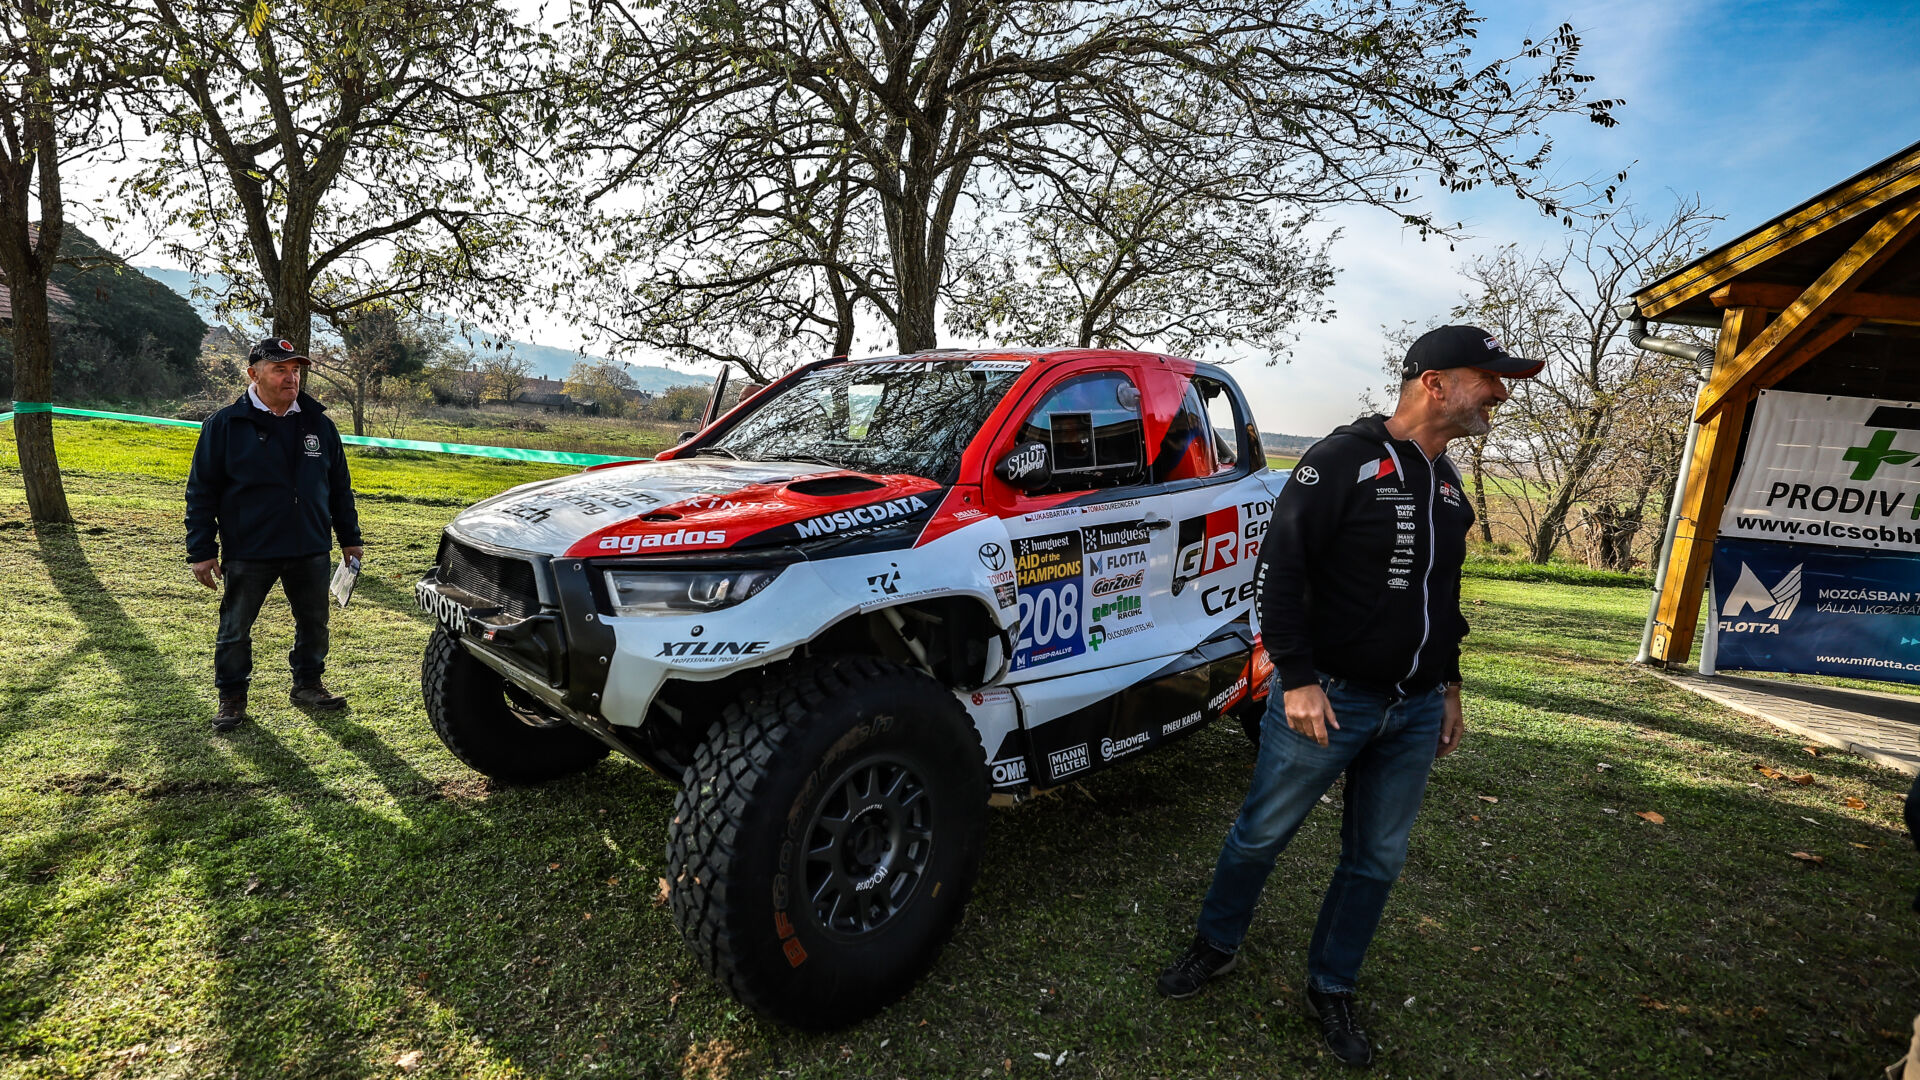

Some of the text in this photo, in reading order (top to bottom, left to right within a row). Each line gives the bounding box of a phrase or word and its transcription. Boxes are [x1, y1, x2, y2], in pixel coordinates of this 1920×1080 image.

[1008, 449, 1046, 480] SHOT
[686, 497, 785, 510] KINTO
[1766, 482, 1905, 517] PRODIV
[794, 496, 928, 539] MUSICDATA
[599, 529, 726, 553] agados
[840, 527, 871, 538] PLUG
[1100, 527, 1150, 545] hunguest
[1031, 535, 1069, 551] hunguest
[1041, 555, 1048, 564] of
[1049, 553, 1060, 562] the
[1107, 551, 1147, 569] FLOTTA
[1176, 531, 1238, 578] GR
[987, 570, 1015, 585] TOYOTA
[1016, 561, 1081, 586] HAMPIONS
[1819, 588, 1910, 602] MOZGÁSBAN
[418, 586, 466, 633] TOYOTA
[1017, 583, 1079, 651] 208
[1118, 608, 1142, 620] RACING
[1718, 621, 1780, 634] FLOTTA
[654, 641, 770, 657] XTLINE
[671, 656, 716, 664] PROFESSIONAL
[1208, 677, 1247, 710] MUSICDATA
[1162, 710, 1201, 734] PNEU KAFKA
[1052, 746, 1086, 765] MANN
[992, 760, 1026, 782] OMP
[1053, 756, 1088, 775] FILTER
